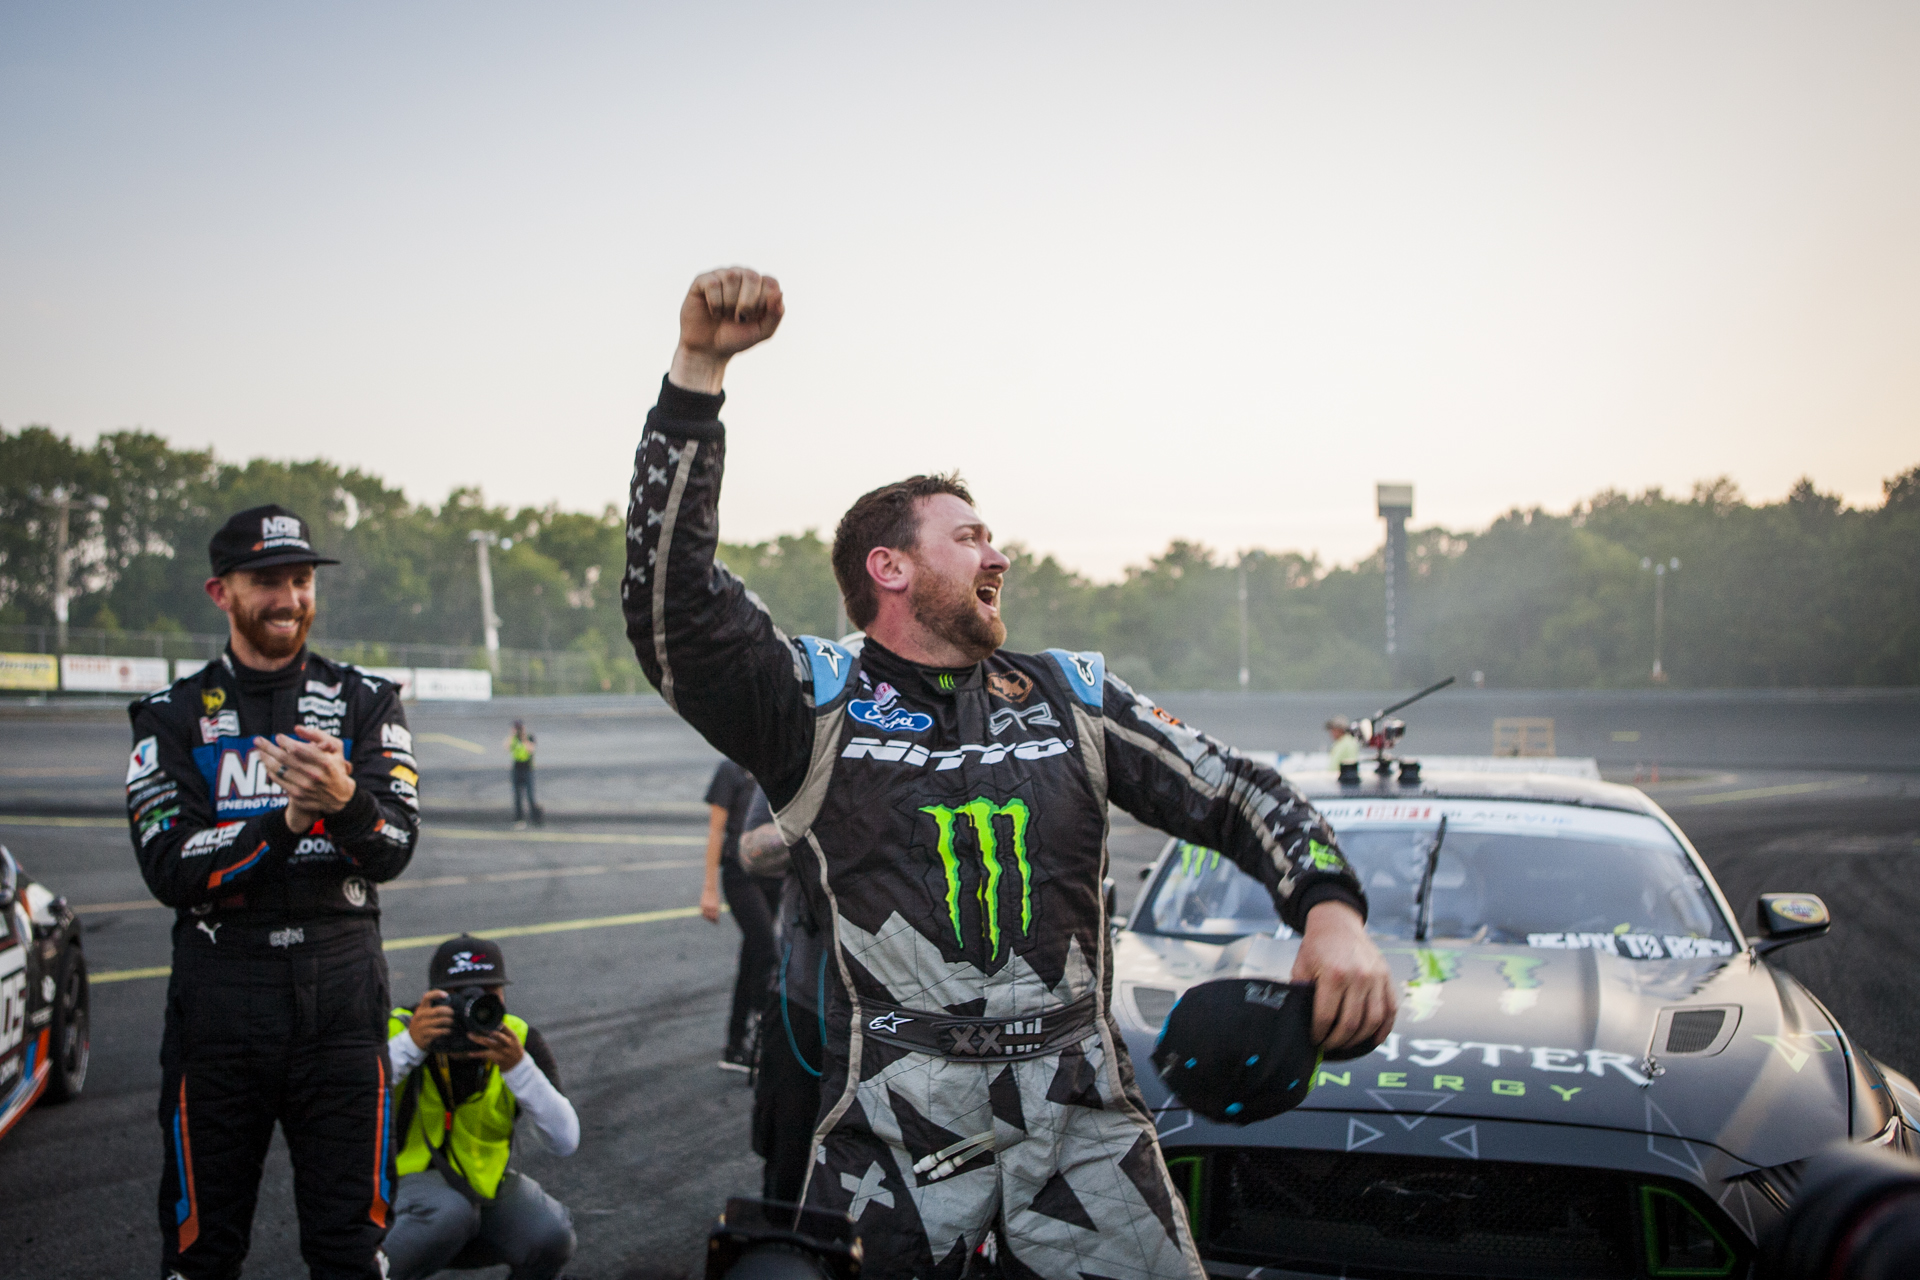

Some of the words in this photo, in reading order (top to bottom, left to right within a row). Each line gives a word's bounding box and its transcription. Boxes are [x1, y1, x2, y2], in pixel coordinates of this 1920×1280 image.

[216, 798, 268, 811] ENERGY
[1374, 1033, 1654, 1087] NSTER
[1317, 1071, 1583, 1101] NERGY
